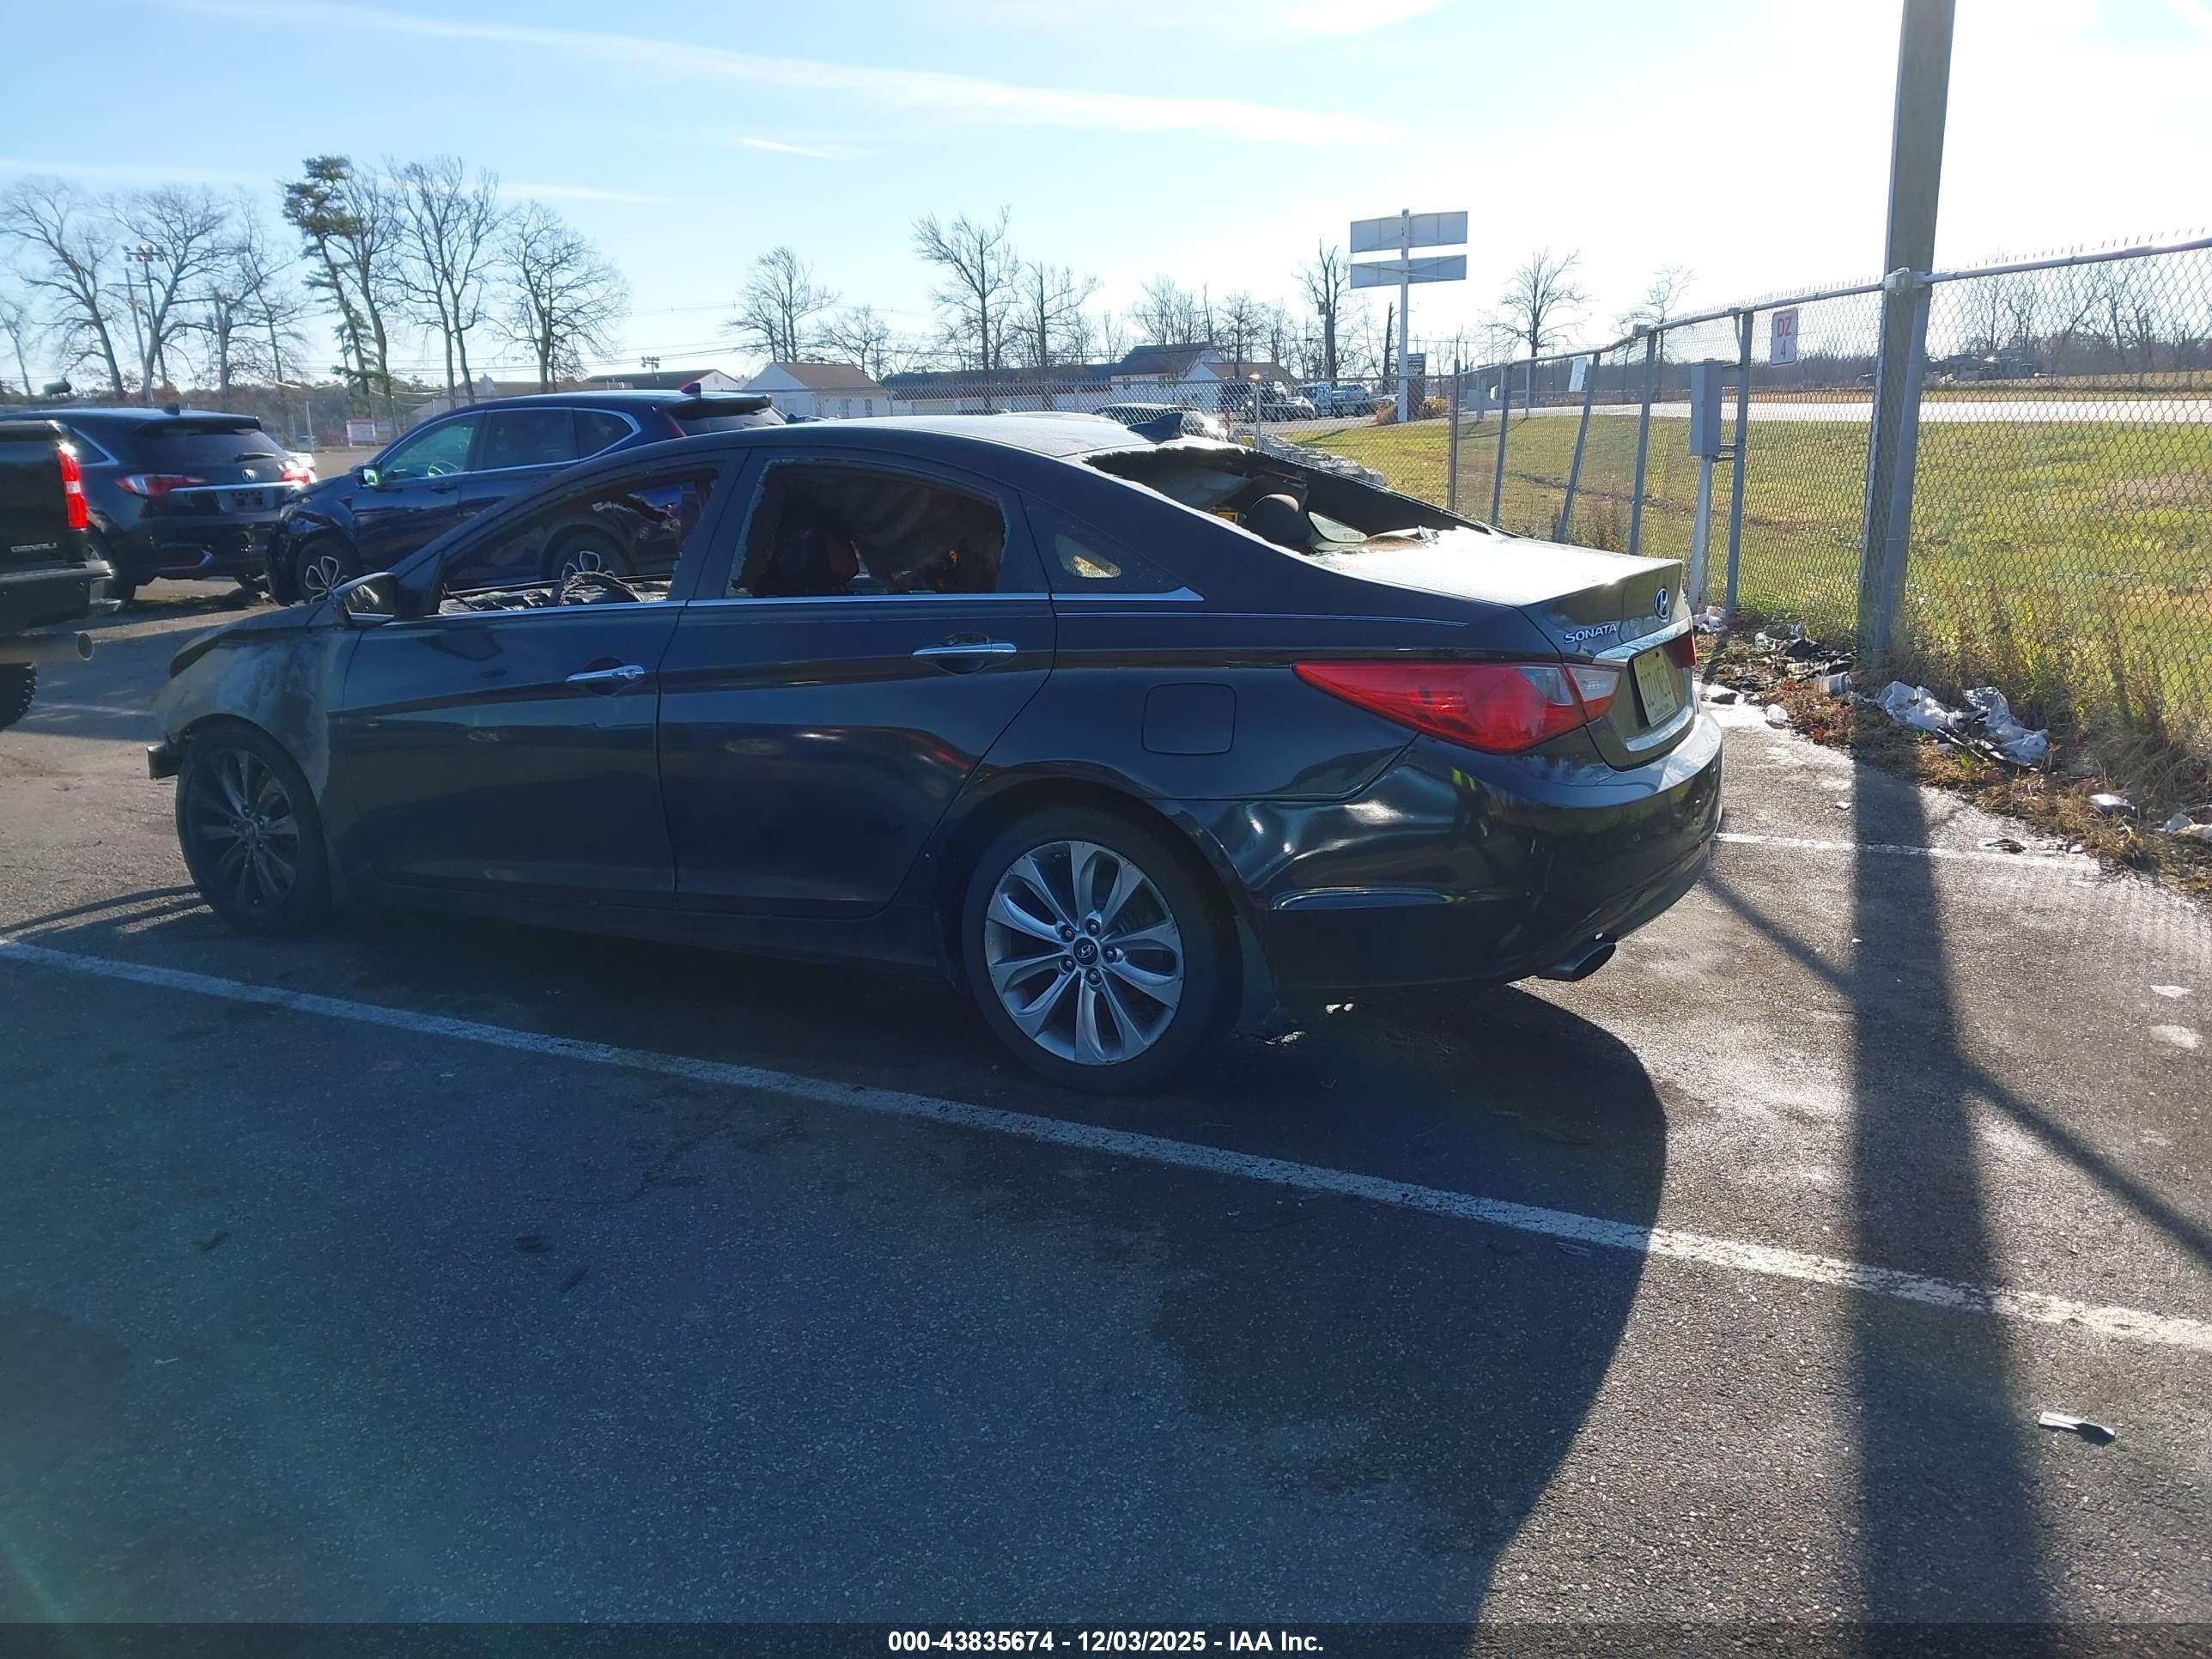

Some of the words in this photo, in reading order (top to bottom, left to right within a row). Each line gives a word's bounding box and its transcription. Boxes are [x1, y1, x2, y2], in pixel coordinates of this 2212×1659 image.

[1778, 316, 1792, 337] DZ
[1780, 339, 1786, 358] 4
[1565, 624, 1617, 644] SONATA
